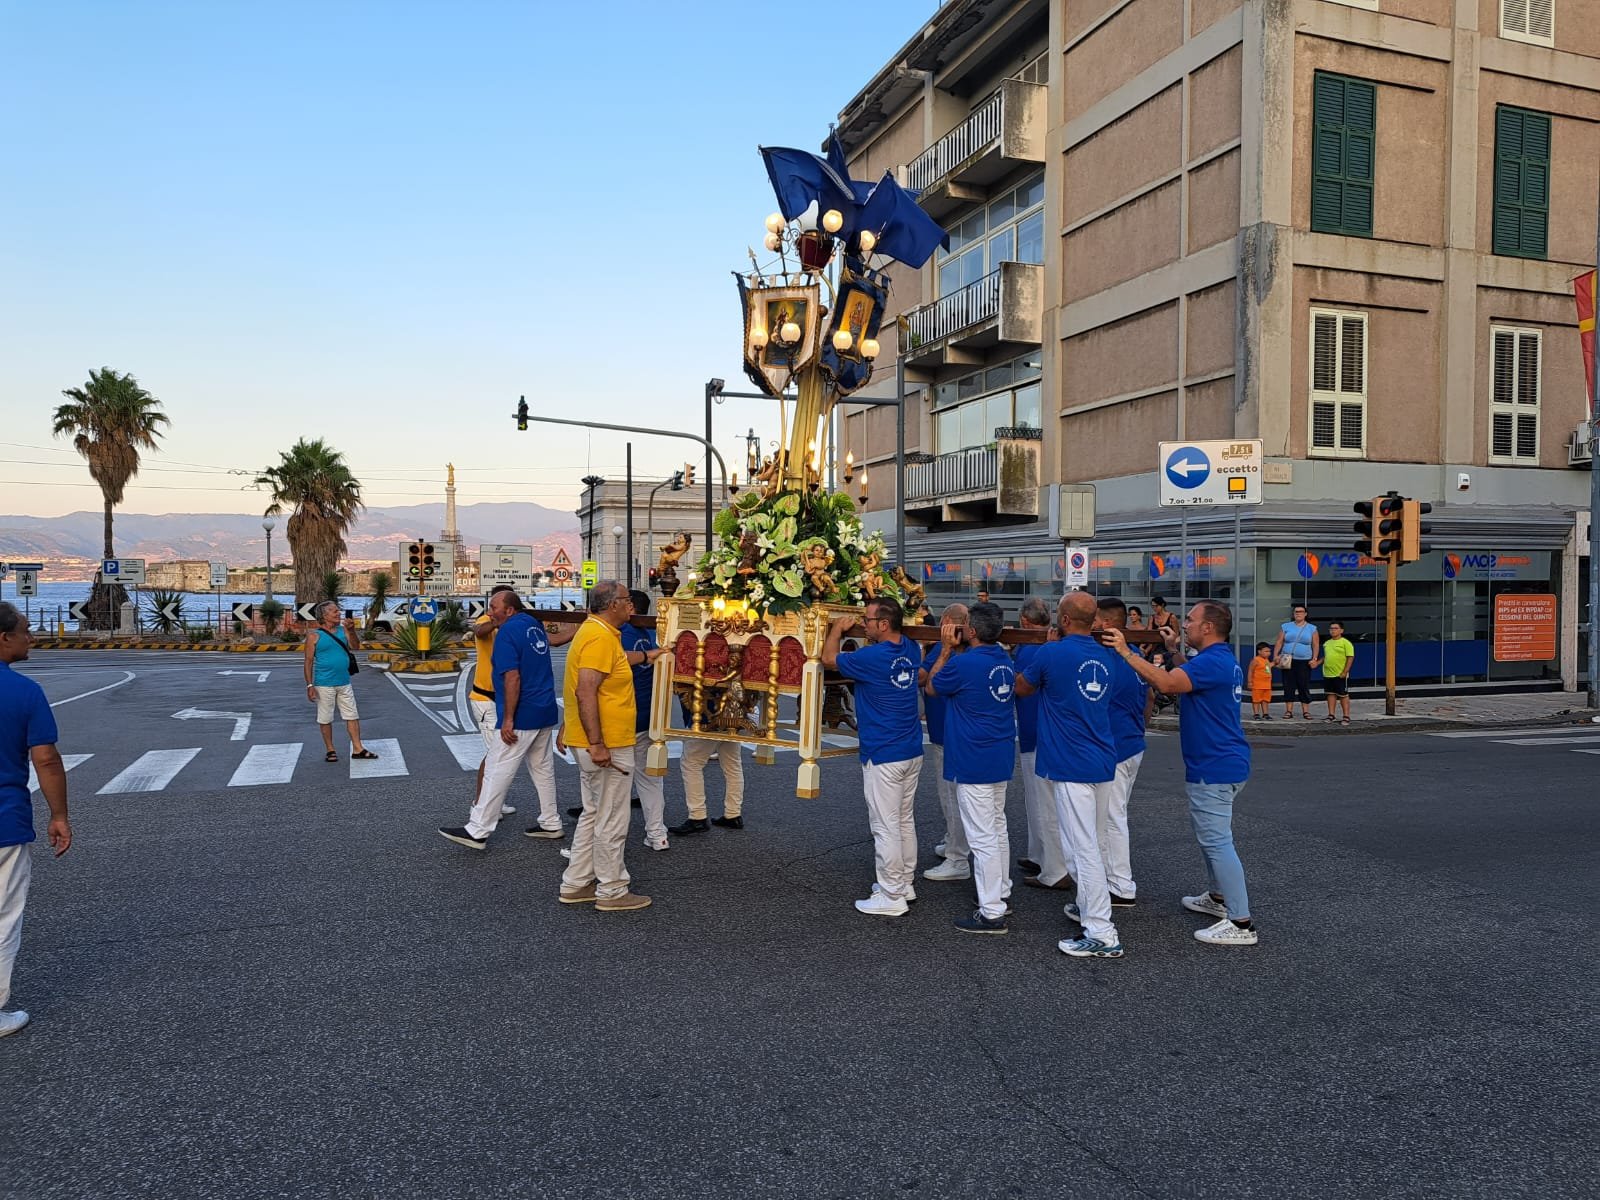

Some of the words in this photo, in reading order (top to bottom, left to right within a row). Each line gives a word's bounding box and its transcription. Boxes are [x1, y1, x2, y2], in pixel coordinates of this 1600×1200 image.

[1216, 464, 1258, 474] eccetto
[106, 562, 116, 573] P
[558, 570, 567, 578] 30
